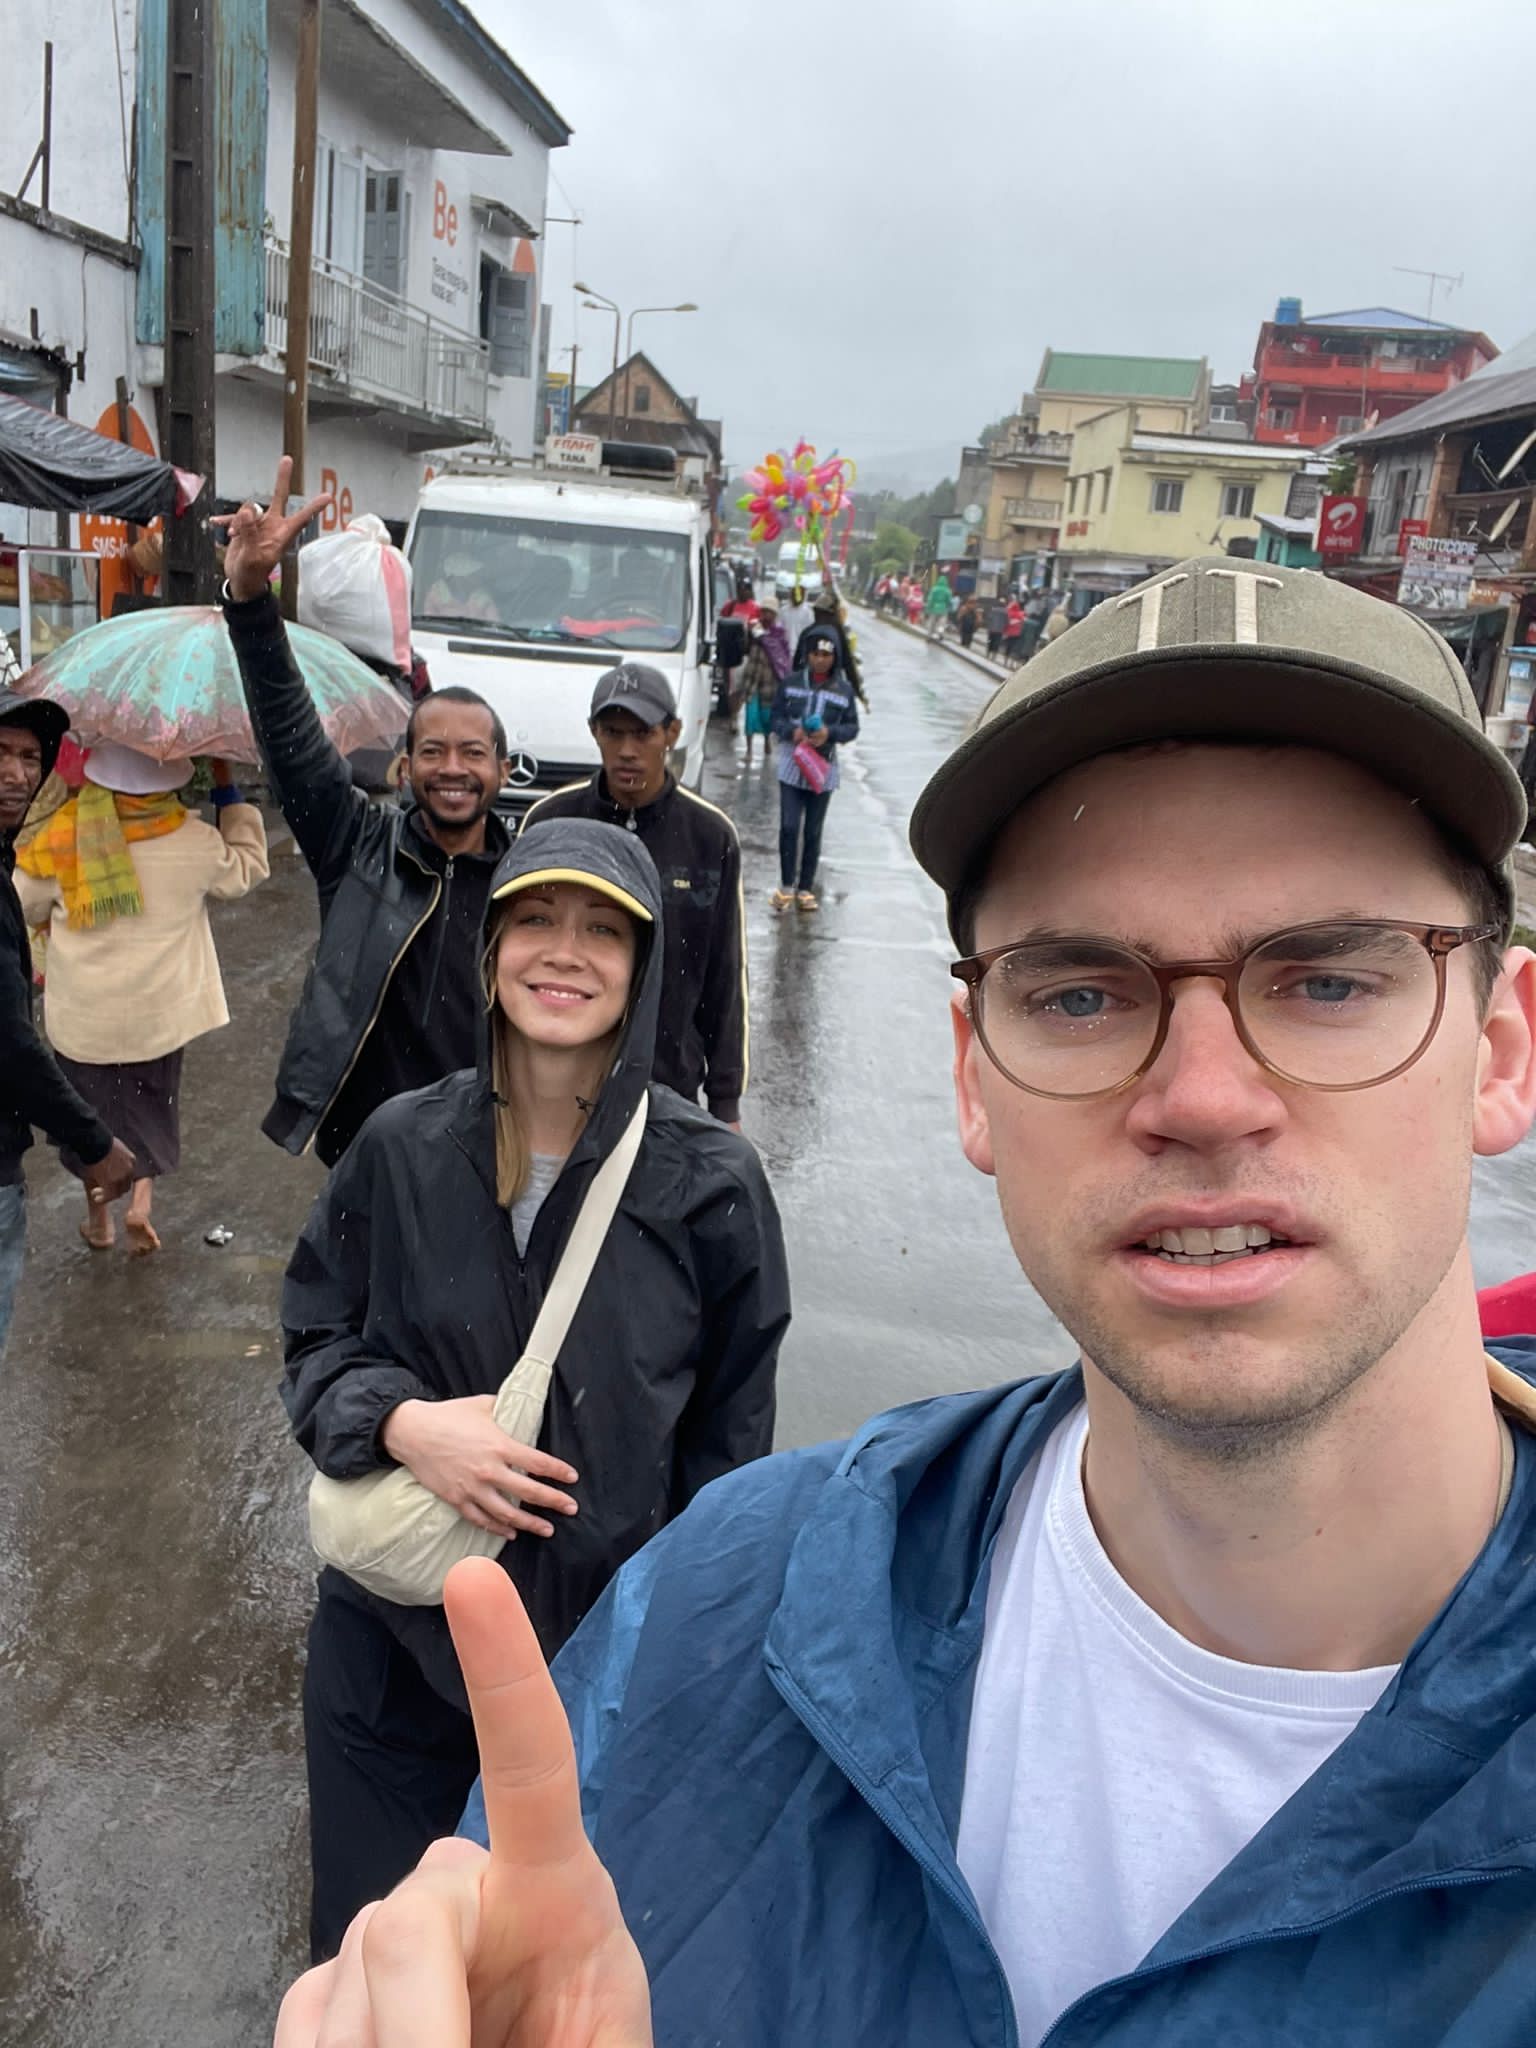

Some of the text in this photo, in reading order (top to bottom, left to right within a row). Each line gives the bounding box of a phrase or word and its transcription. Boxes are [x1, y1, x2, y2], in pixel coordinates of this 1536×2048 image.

[432, 178, 457, 246] Be
[561, 453, 586, 463] TANA
[322, 467, 353, 531] Be
[1324, 534, 1353, 547] airtel
[1410, 535, 1478, 555] PHOTOCOPIE
